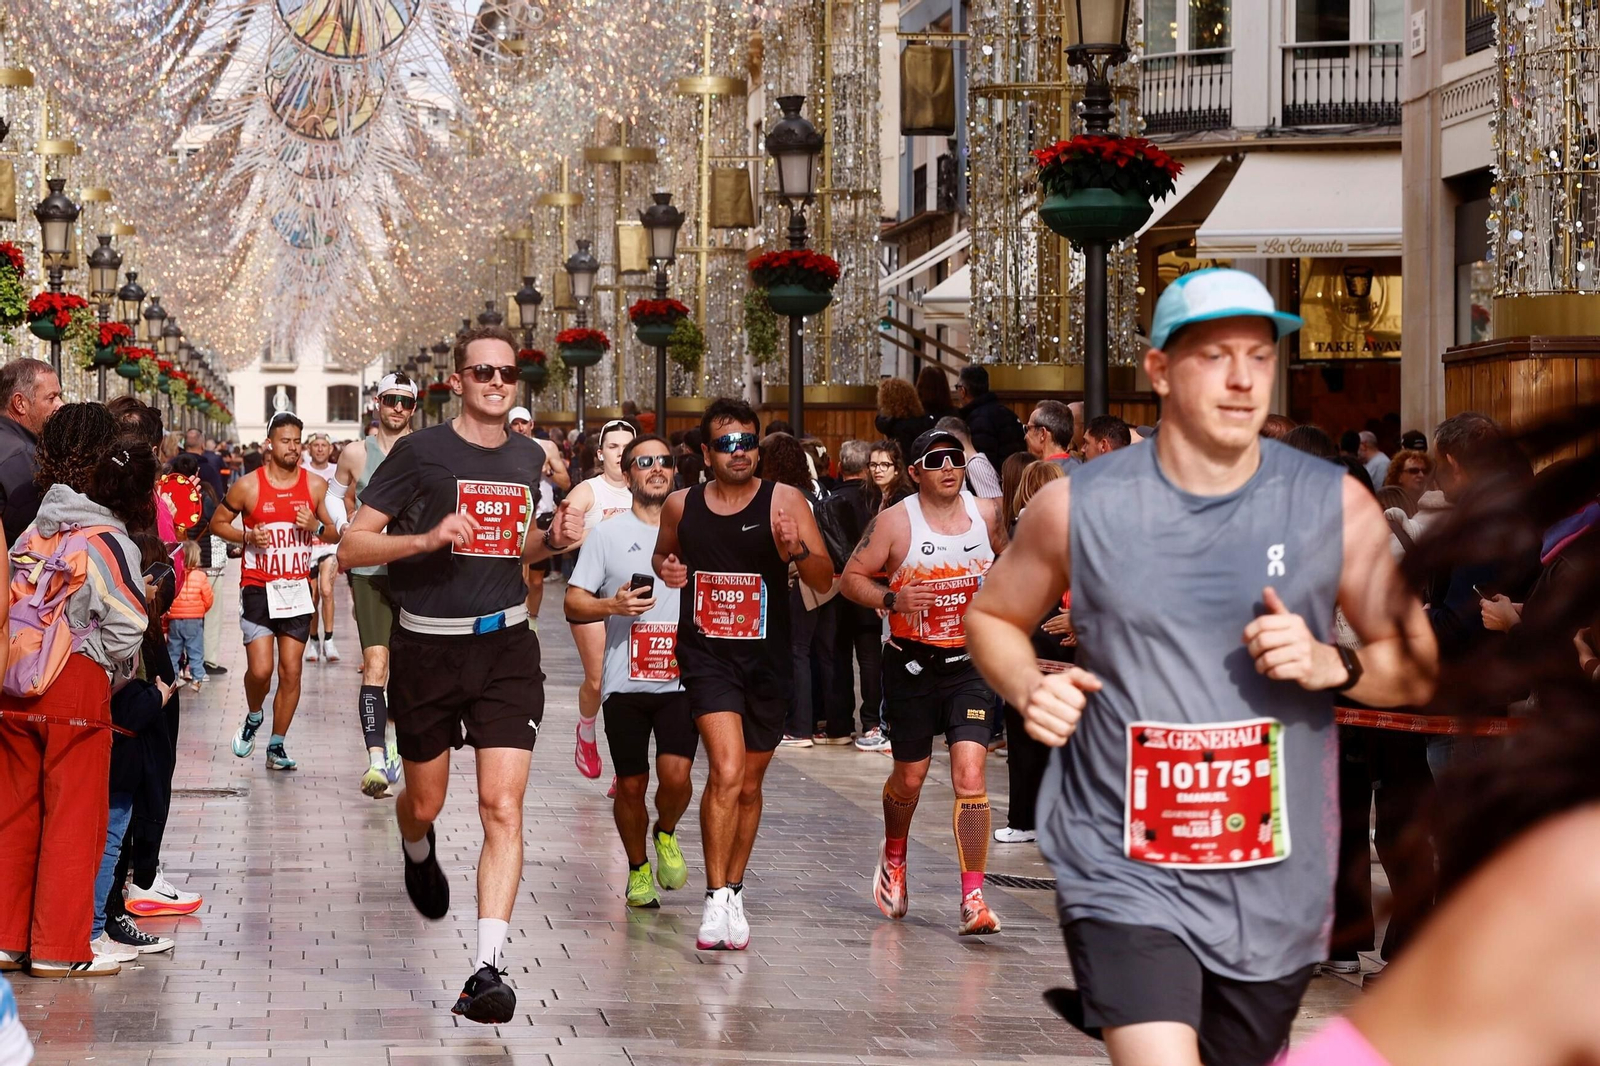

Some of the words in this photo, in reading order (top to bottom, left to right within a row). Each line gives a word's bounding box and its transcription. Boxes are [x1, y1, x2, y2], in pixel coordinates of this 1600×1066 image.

[1262, 238, 1285, 254] La
[1288, 237, 1344, 254] Canasta
[1315, 342, 1354, 352] TAKE
[1362, 341, 1401, 352] AWAY
[478, 485, 522, 497] GENERALI
[475, 500, 511, 516] 8681
[257, 528, 312, 549] ARATO
[711, 575, 756, 586] GENERALI
[934, 577, 975, 591] GENERALI
[711, 589, 745, 603] 5089
[934, 592, 967, 607] 5256
[649, 636, 673, 649] 729
[363, 693, 377, 732] kalenji
[1167, 725, 1262, 750] GENERALI
[1155, 759, 1251, 789] 10175
